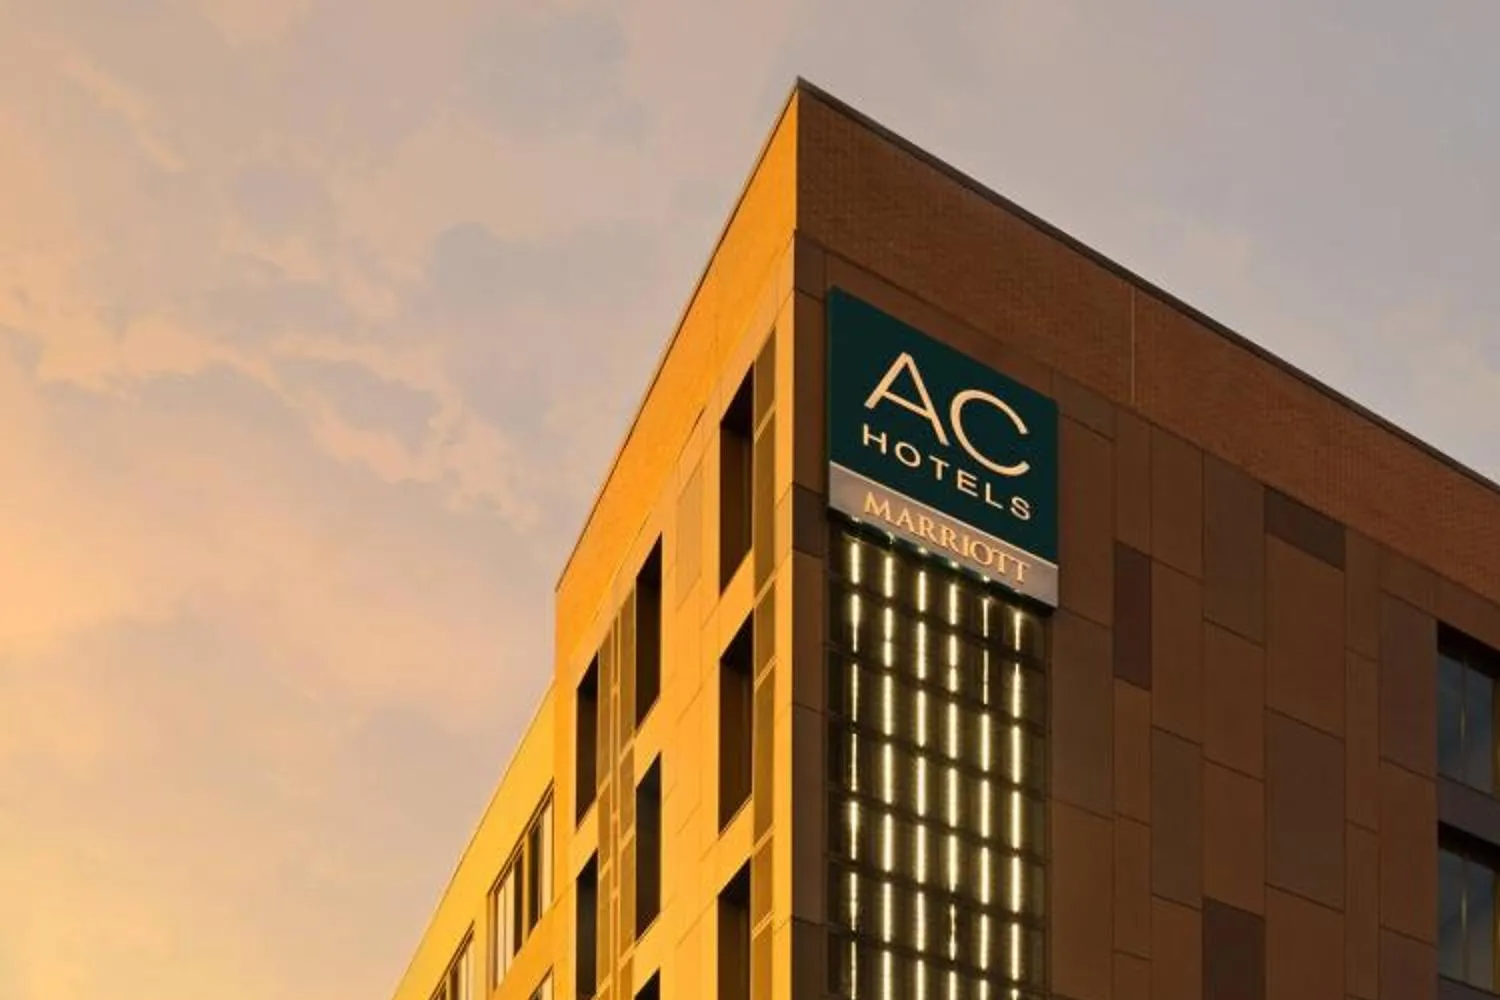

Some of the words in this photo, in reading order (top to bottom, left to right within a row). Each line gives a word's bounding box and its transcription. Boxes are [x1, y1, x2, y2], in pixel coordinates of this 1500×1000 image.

[864, 352, 1029, 476] AC
[862, 424, 1031, 521] HOTELS
[864, 491, 1031, 583] MARRIOTT
